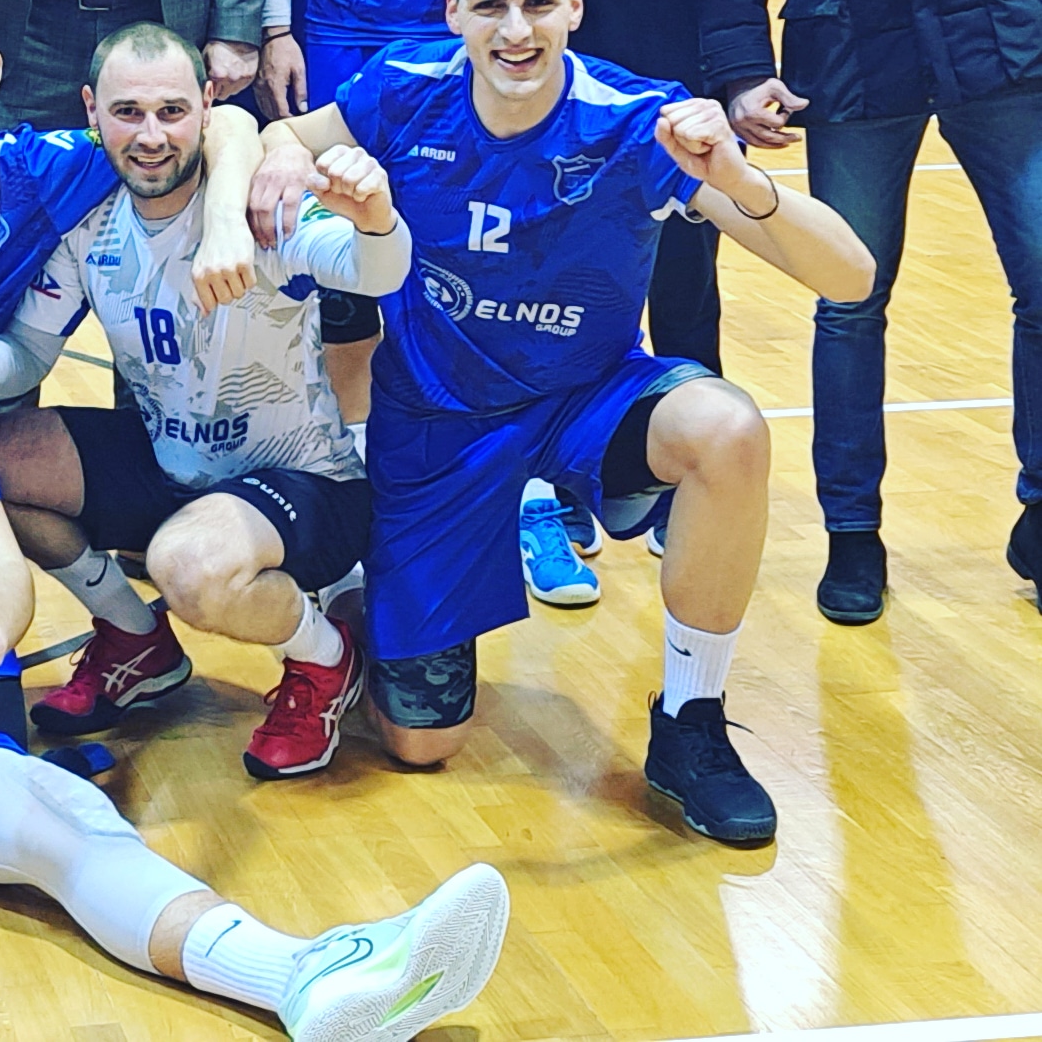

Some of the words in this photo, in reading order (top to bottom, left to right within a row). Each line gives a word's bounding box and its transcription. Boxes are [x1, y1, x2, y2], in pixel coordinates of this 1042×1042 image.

[467, 200, 513, 254] 12
[474, 299, 586, 328] ELNOS
[134, 306, 182, 366] 18
[534, 323, 578, 338] GROUP
[165, 412, 250, 444] ELNOS
[210, 436, 248, 453] GROUP
